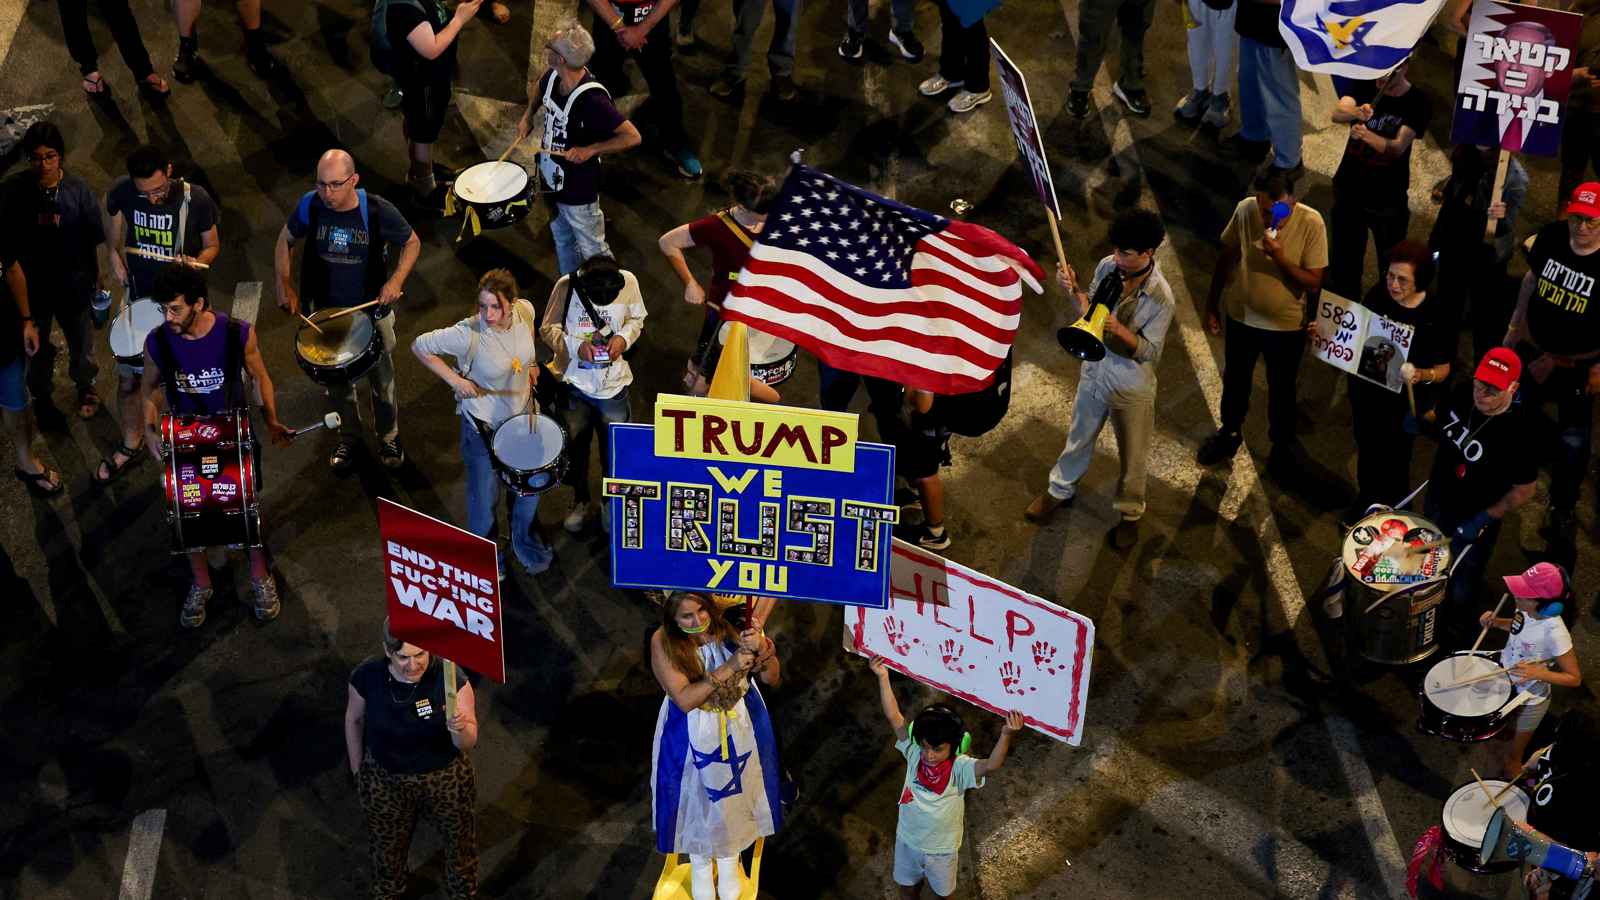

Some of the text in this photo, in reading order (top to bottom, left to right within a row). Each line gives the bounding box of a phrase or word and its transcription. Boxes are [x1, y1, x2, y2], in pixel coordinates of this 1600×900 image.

[1473, 32, 1571, 72] קטאר
[1462, 86, 1560, 124] בגידה
[133, 209, 173, 230] למה הם
[134, 225, 173, 246] עדיין
[1542, 258, 1596, 297] בלעדיהם
[1565, 292, 1588, 314] הלך
[1314, 334, 1353, 361] הפקרה
[1335, 329, 1352, 343] ימי
[188, 377, 225, 387] עומדים
[661, 408, 849, 465] TRUMP
[1442, 410, 1483, 462] 7.10
[707, 466, 783, 498] WE
[603, 477, 900, 573] TRUST
[387, 540, 494, 595] END THIS
[706, 558, 788, 593] YOU
[390, 576, 496, 642] WAR
[888, 572, 1036, 653] HELP
